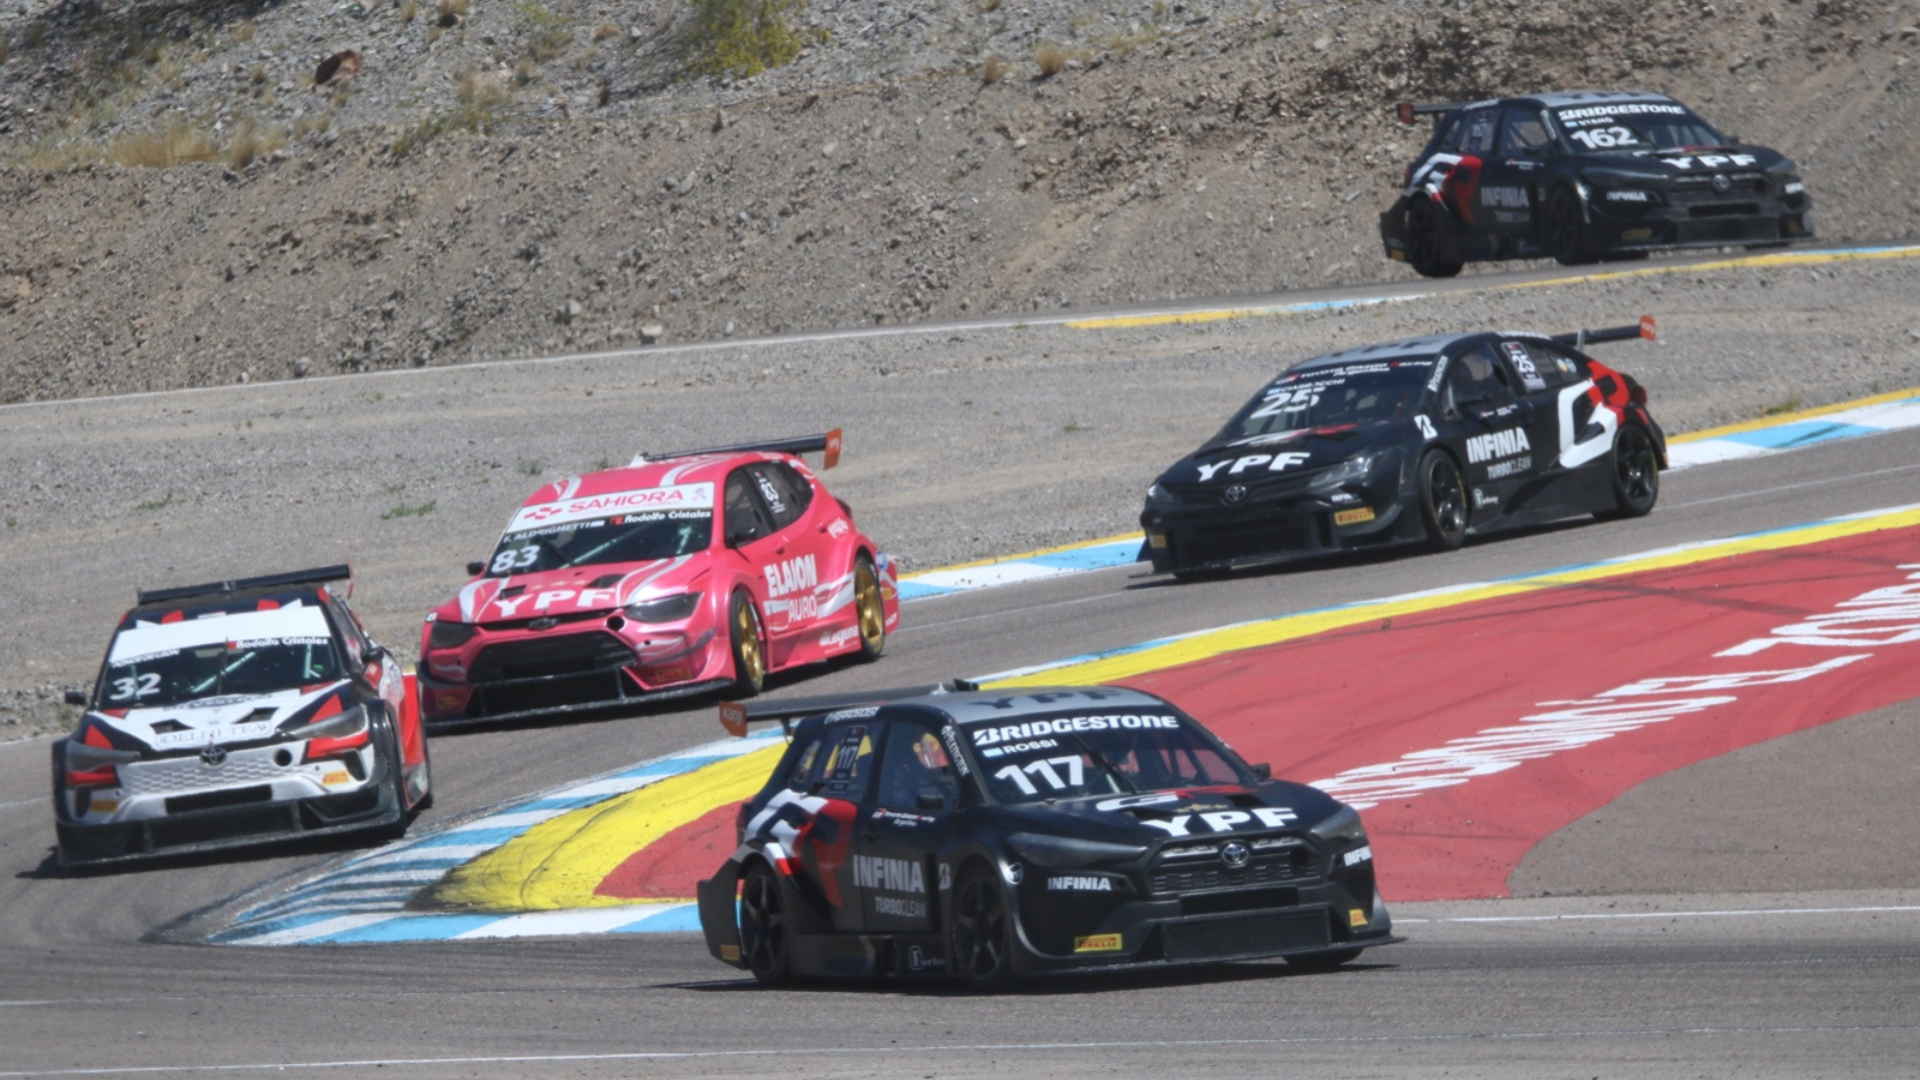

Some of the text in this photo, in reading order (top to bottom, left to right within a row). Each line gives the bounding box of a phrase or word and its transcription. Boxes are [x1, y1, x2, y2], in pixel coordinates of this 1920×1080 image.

[1558, 103, 1686, 121] BRIDGESTONE
[1570, 126, 1638, 149] 162
[1660, 154, 1757, 169] YPF
[1481, 186, 1530, 208] INFINIA
[1511, 354, 1536, 373] 25
[1250, 387, 1326, 419] 25
[1466, 427, 1530, 463] INFINIA
[1197, 452, 1311, 482] YPF
[568, 490, 684, 513] SAHIORA
[624, 510, 711, 525] Rodolfo Cristales
[491, 545, 541, 573] 83
[764, 553, 817, 598] ELAION
[493, 589, 616, 617] YPF
[788, 595, 817, 623] AURO
[236, 636, 329, 650] Rodolfo Cristales
[109, 672, 162, 700] 32
[973, 715, 1180, 746] BRIDGESTONE
[1003, 738, 1059, 754] ROSSI
[994, 755, 1084, 795] 117
[1140, 807, 1297, 837] YPF
[853, 854, 925, 893] INFINIA
[1048, 876, 1112, 892] INFINIA
[874, 896, 926, 918] TURBOCLEAN
[1079, 937, 1118, 949] PIRELLI
